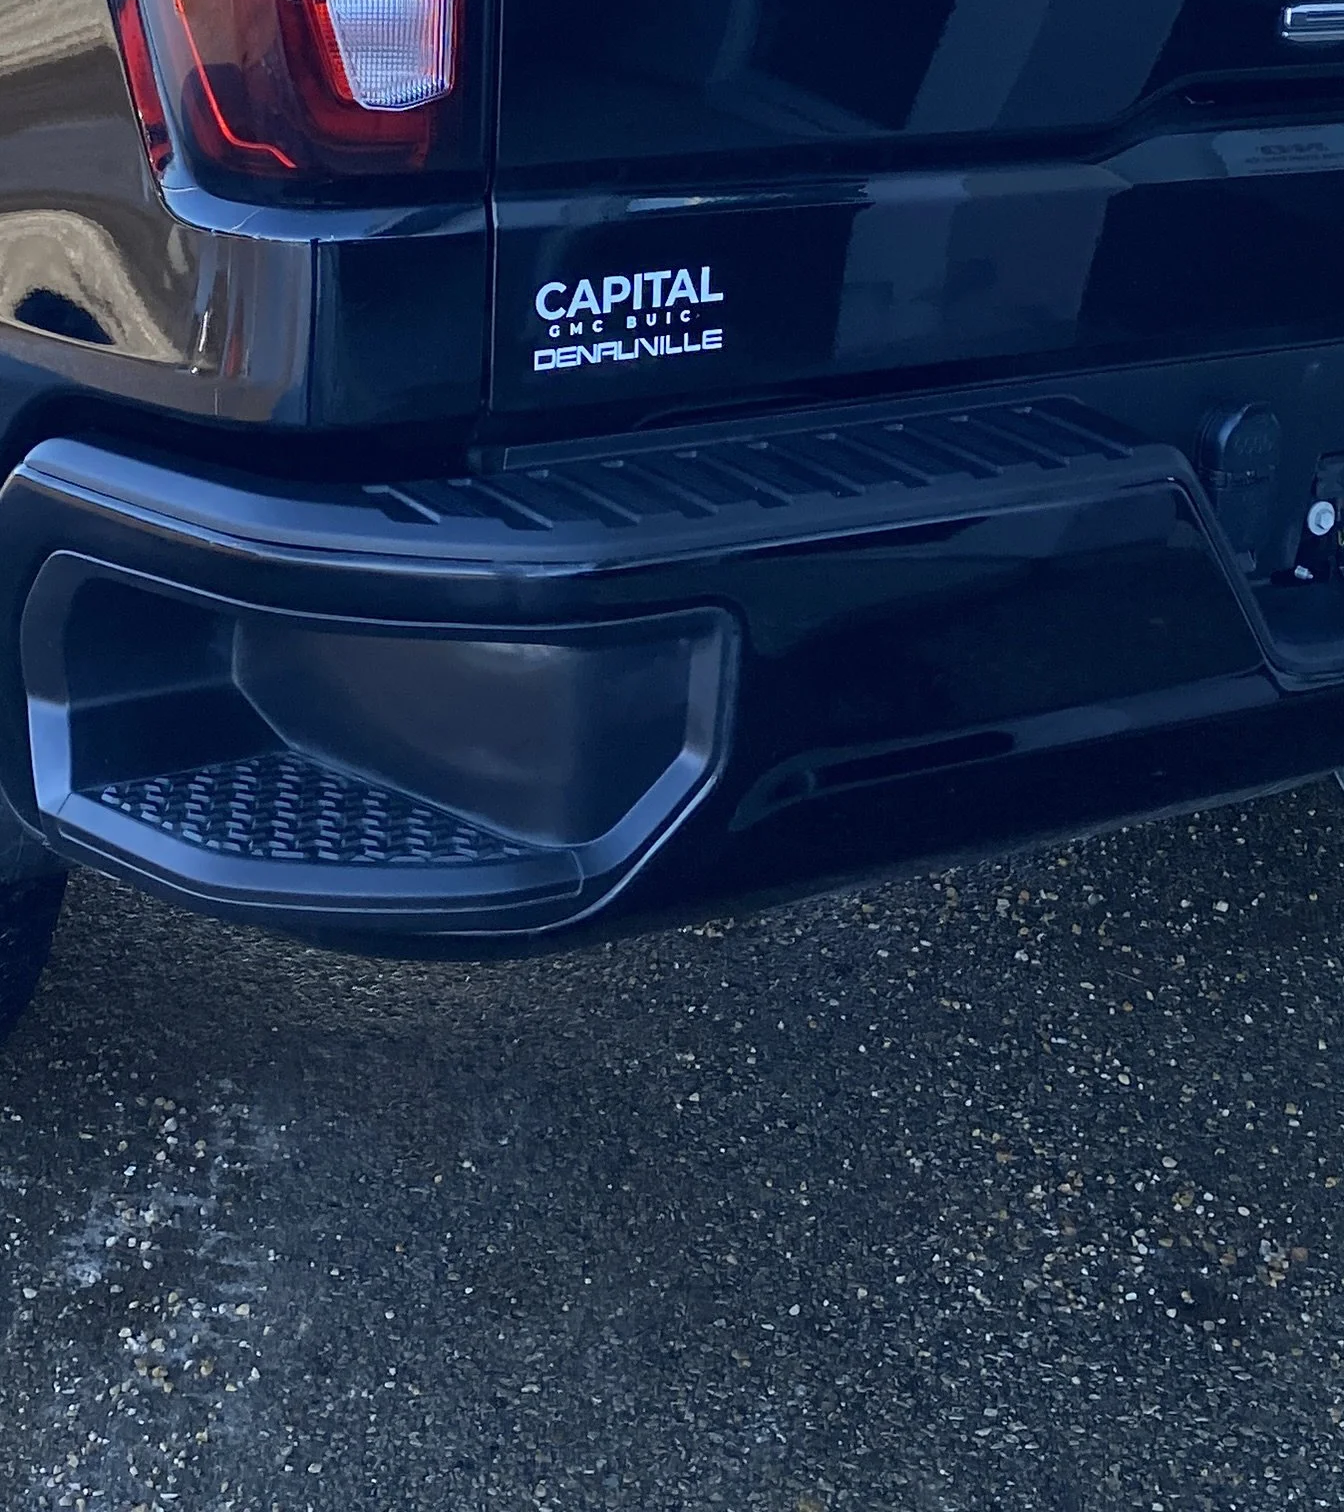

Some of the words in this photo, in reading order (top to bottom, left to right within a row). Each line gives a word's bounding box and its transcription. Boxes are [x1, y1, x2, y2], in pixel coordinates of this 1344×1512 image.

[535, 266, 724, 321] CAPITAL
[548, 319, 604, 339] GMC
[626, 309, 701, 329] BUIC
